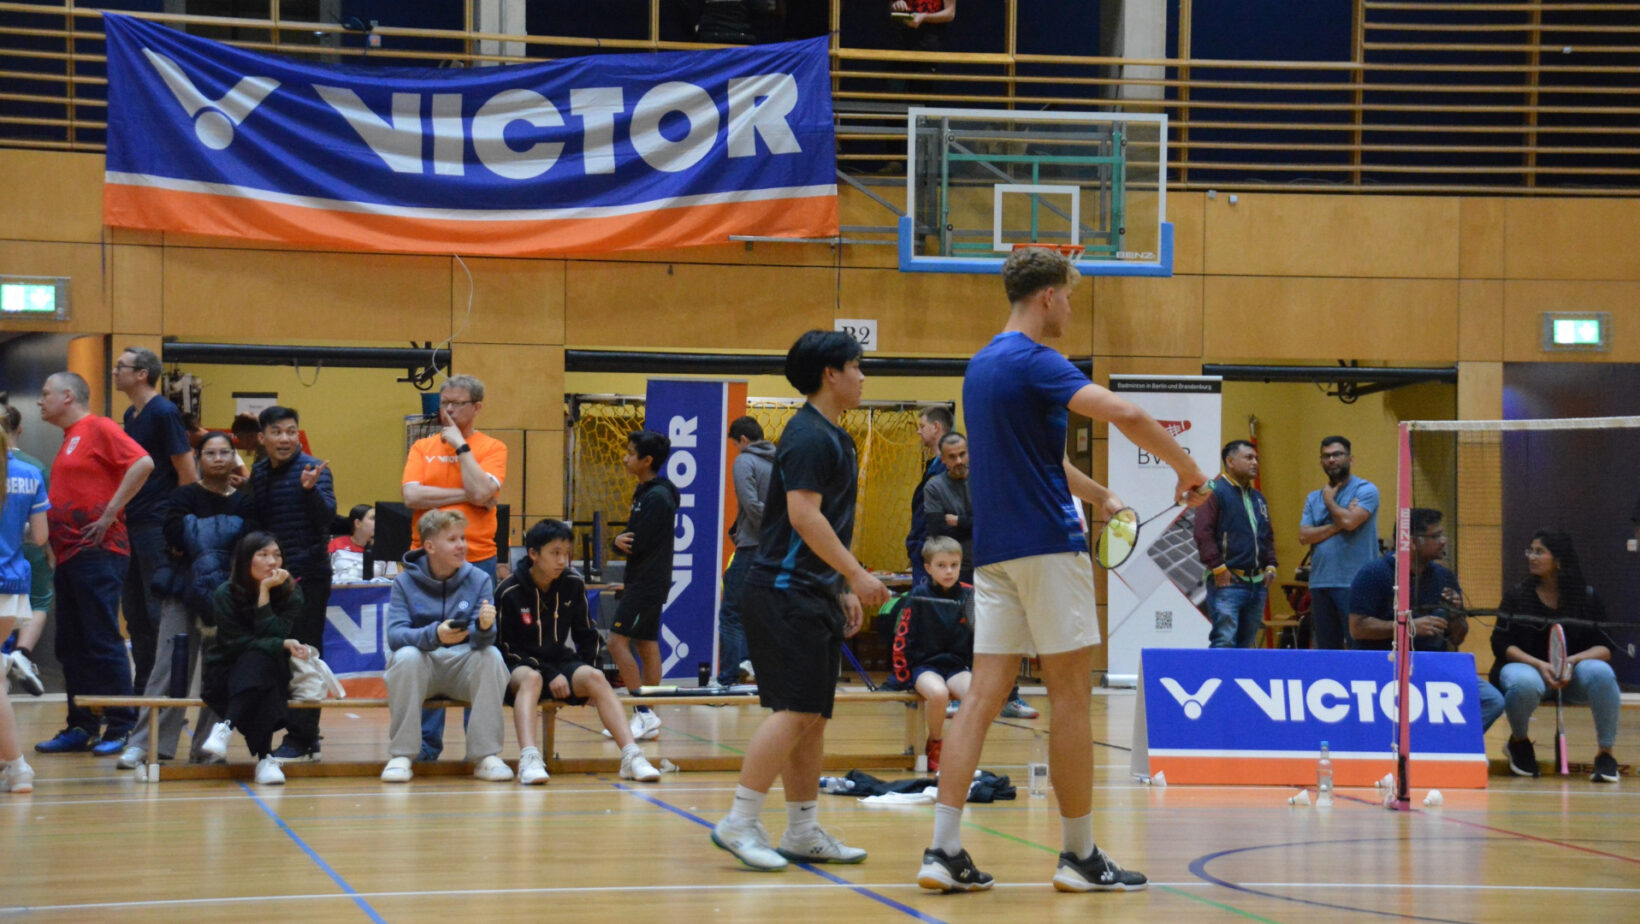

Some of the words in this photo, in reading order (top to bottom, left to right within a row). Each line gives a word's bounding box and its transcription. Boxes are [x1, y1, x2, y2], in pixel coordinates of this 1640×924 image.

[311, 73, 803, 180] VICTOR
[1179, 383, 1212, 391] Brandenburg
[1235, 678, 1467, 723] VICTOR
